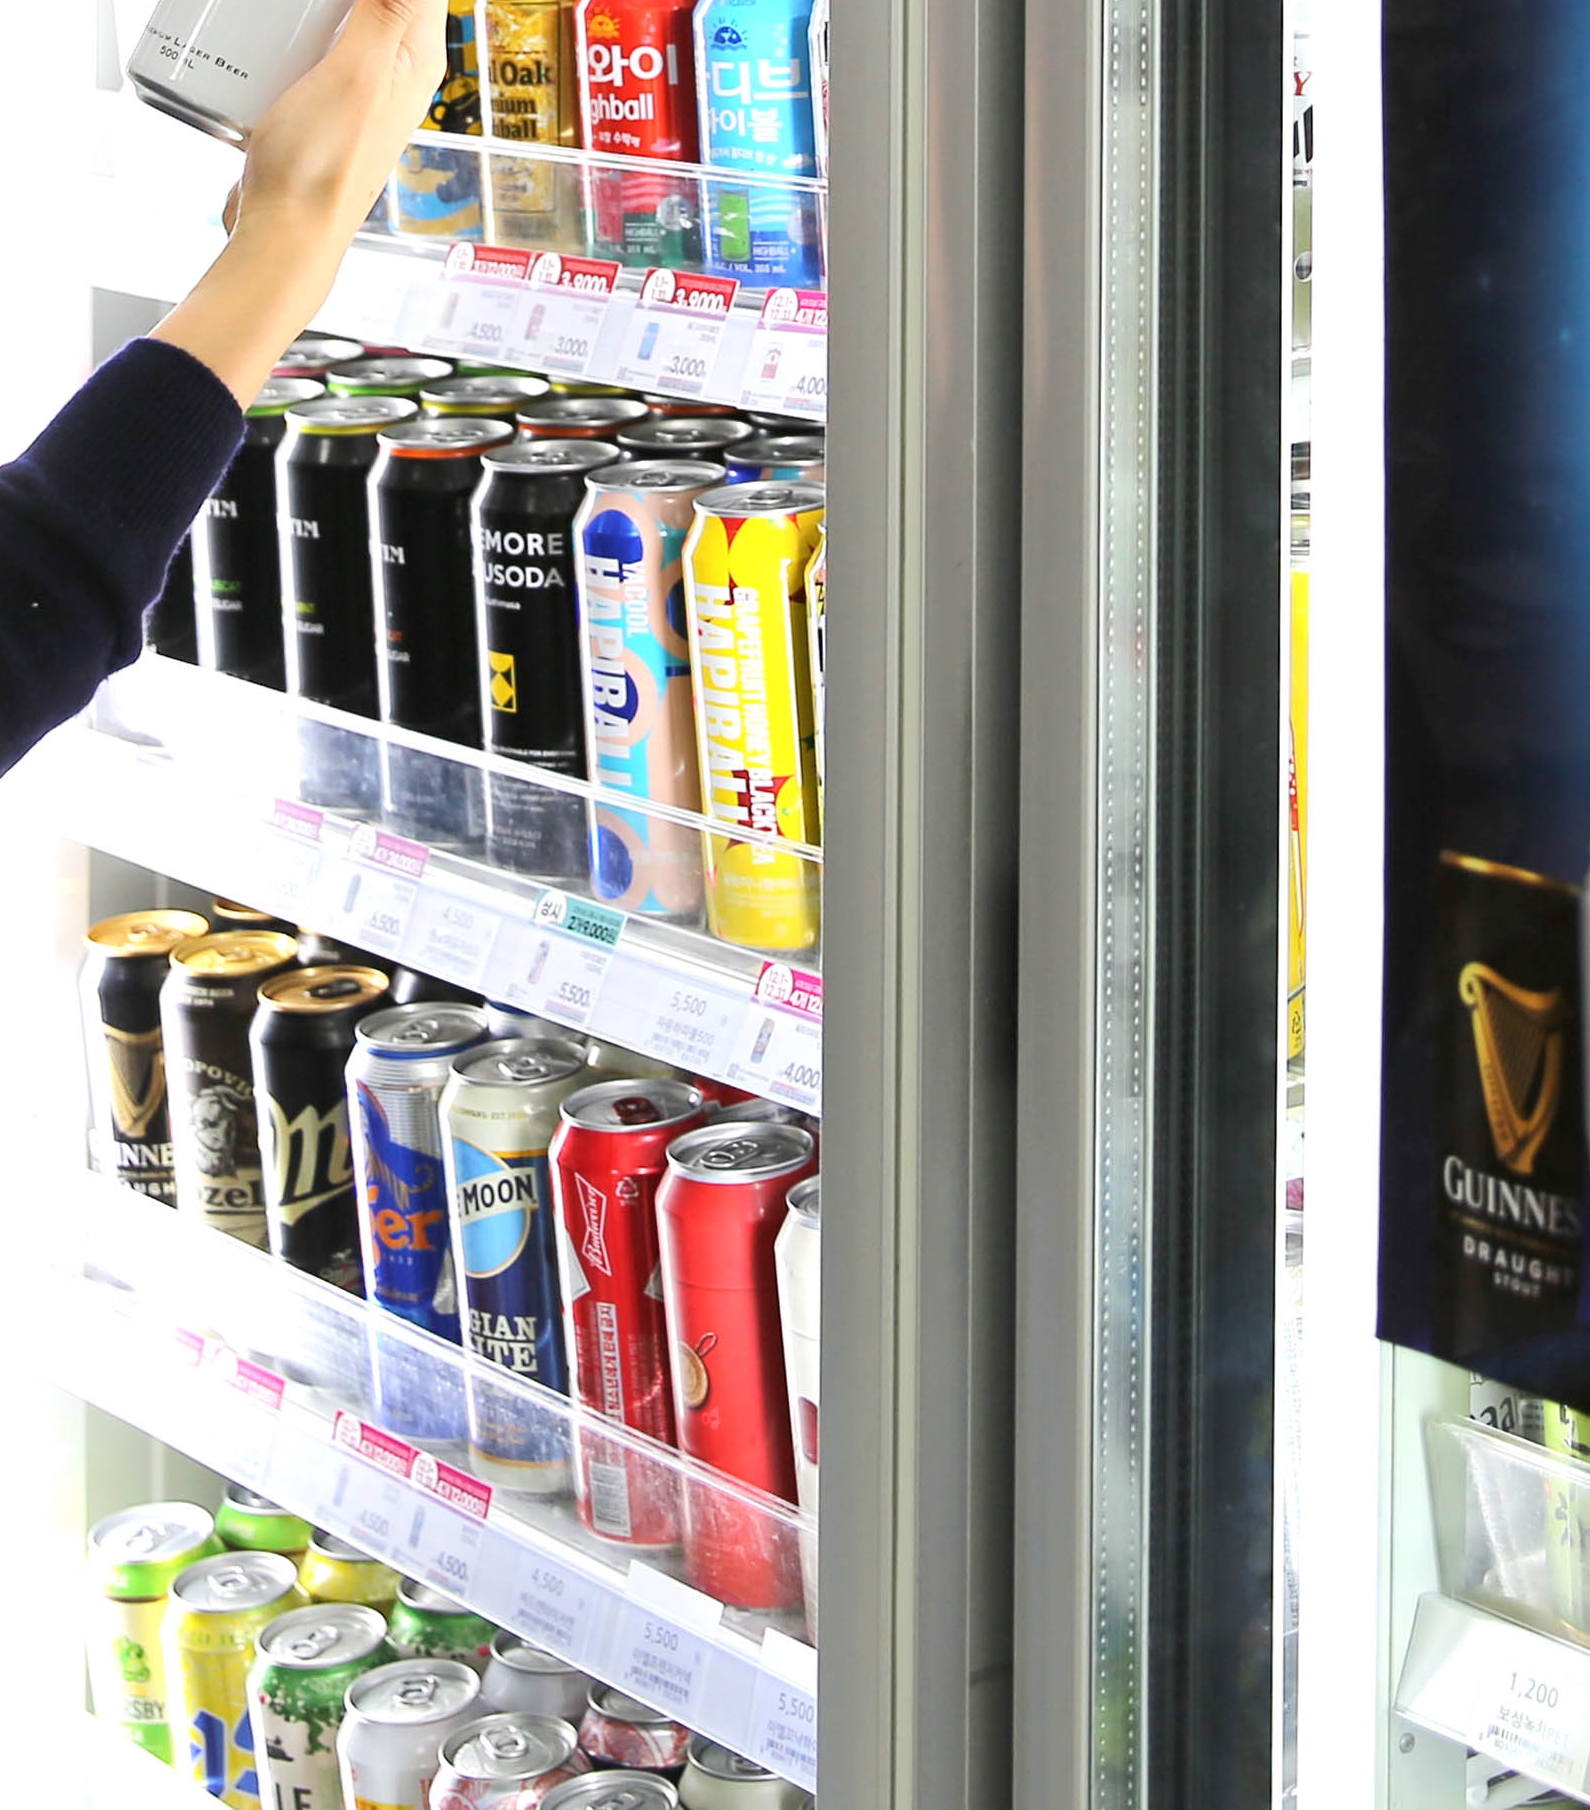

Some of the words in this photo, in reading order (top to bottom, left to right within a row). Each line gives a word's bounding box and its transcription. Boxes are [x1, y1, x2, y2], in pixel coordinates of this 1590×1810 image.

[160, 46, 178, 60] 500
[215, 56, 249, 80] BEER
[500, 60, 553, 87] Oak
[733, 587, 767, 701] GRAPEFRUIT
[584, 555, 633, 787] HAPIBALL
[694, 581, 751, 822] HAPIBALL
[742, 702, 772, 767] HONEY
[541, 898, 563, 921] 상시
[669, 991, 708, 1017] 5,500
[785, 1061, 820, 1089] 4,000
[464, 1173, 534, 1215] MOON
[1442, 1155, 1581, 1236] GUINNES
[1462, 1234, 1575, 1288] DRAUGHT
[643, 1621, 679, 1651] 5,500
[1509, 1672, 1559, 1709] 1,200
